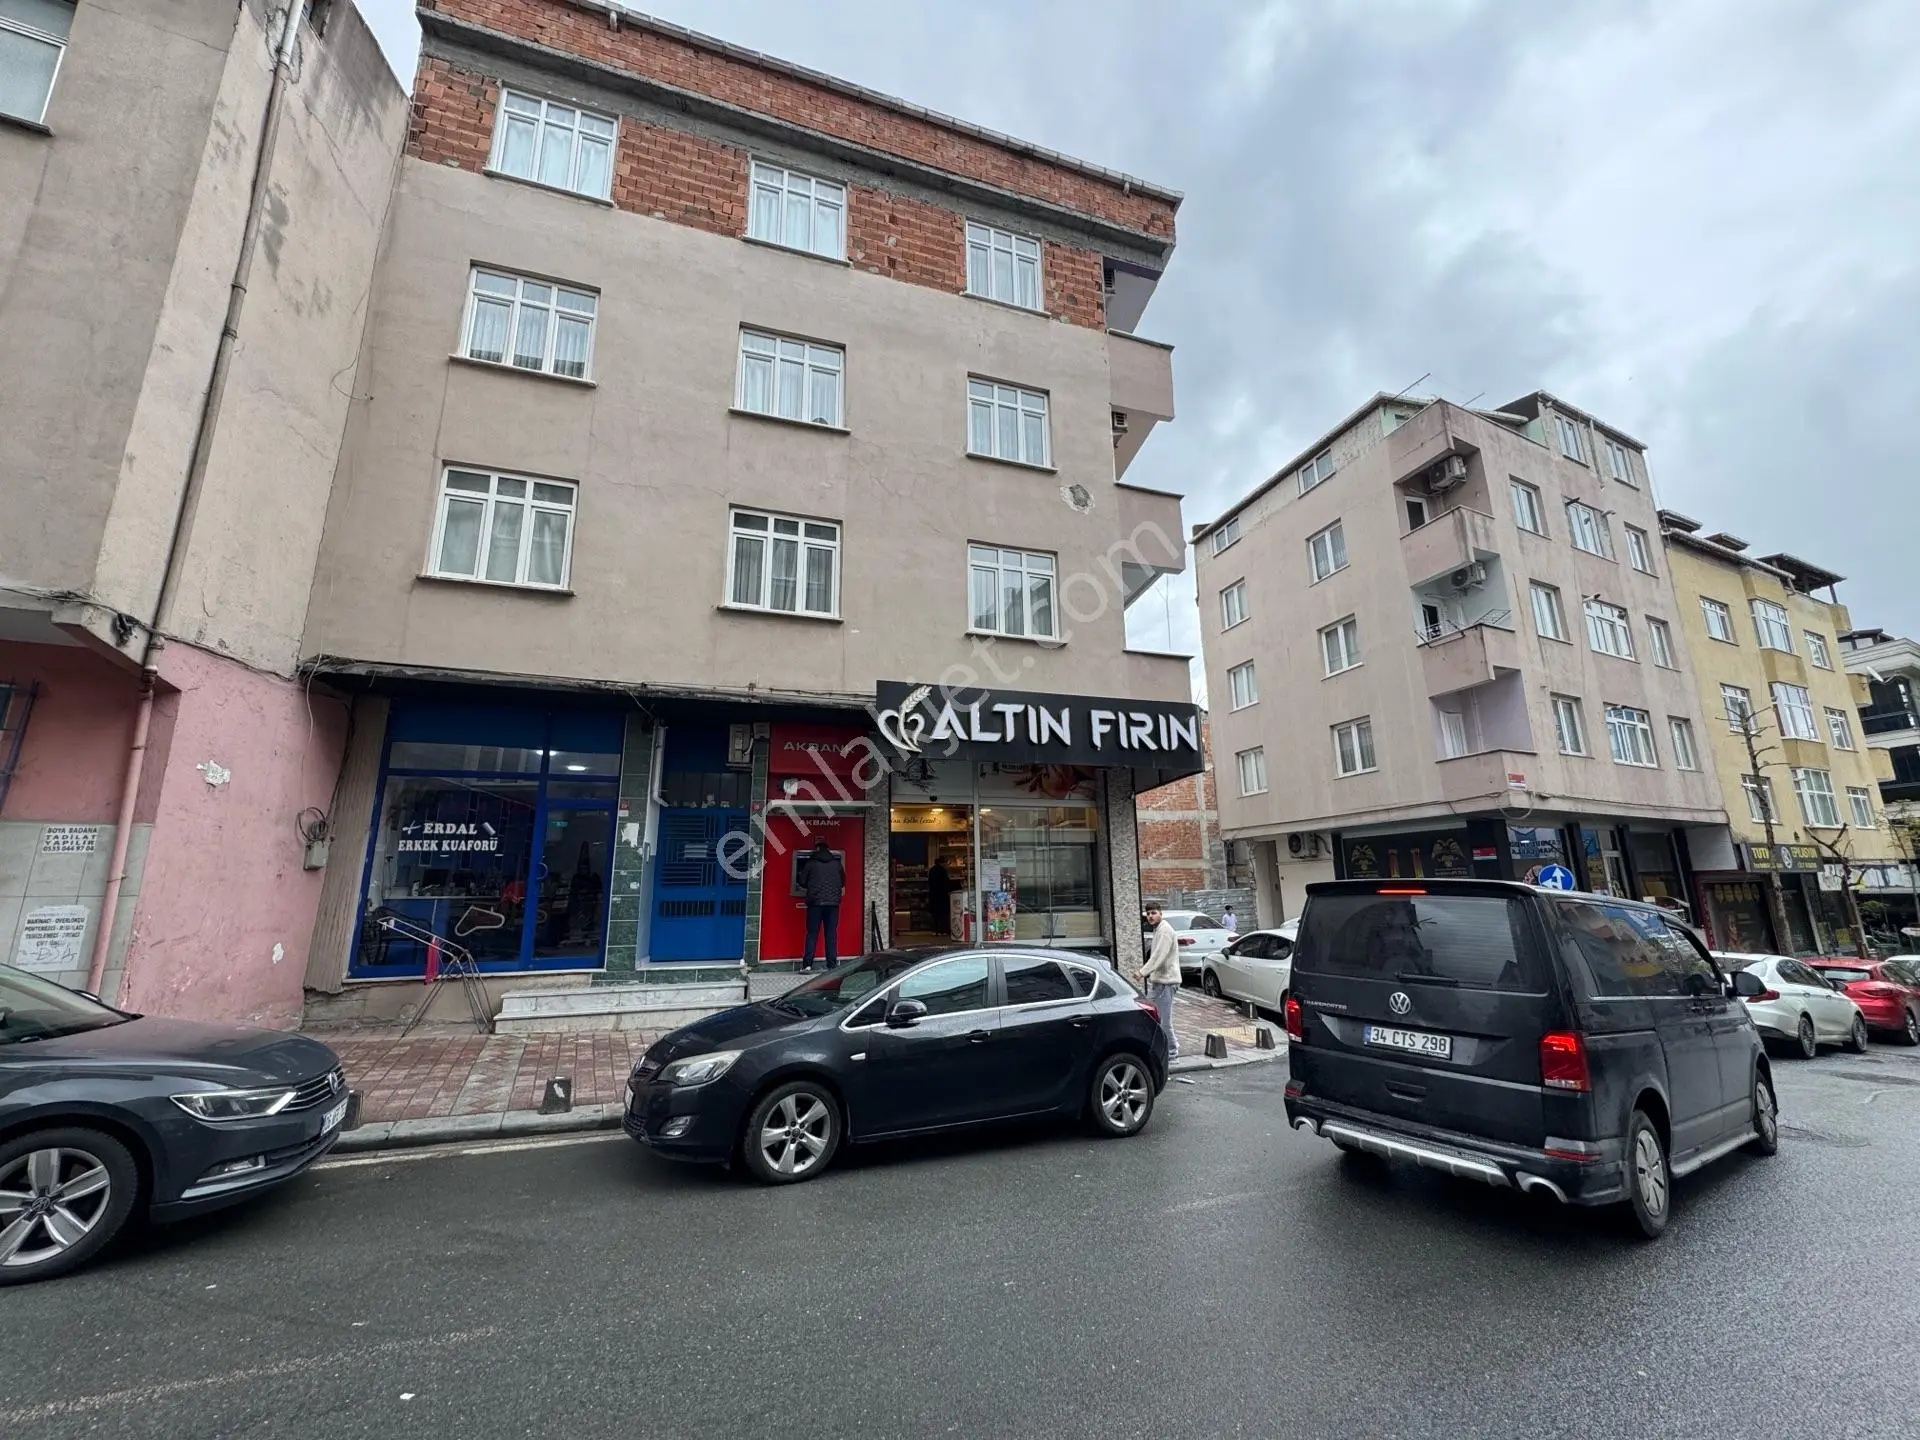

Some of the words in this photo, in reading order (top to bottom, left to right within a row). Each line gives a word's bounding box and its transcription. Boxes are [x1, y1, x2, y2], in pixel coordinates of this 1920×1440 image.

[929, 701, 1071, 747] ALTIN
[1090, 709, 1199, 752] FIRIN
[783, 741, 854, 754] AKBANK
[423, 822, 478, 835] ERDAL
[800, 819, 841, 827] AKBANK
[398, 839, 439, 852] ERKEK
[1371, 1027, 1388, 1043] 34
[1391, 1031, 1417, 1048] CTS
[1421, 1036, 1448, 1052] 298
